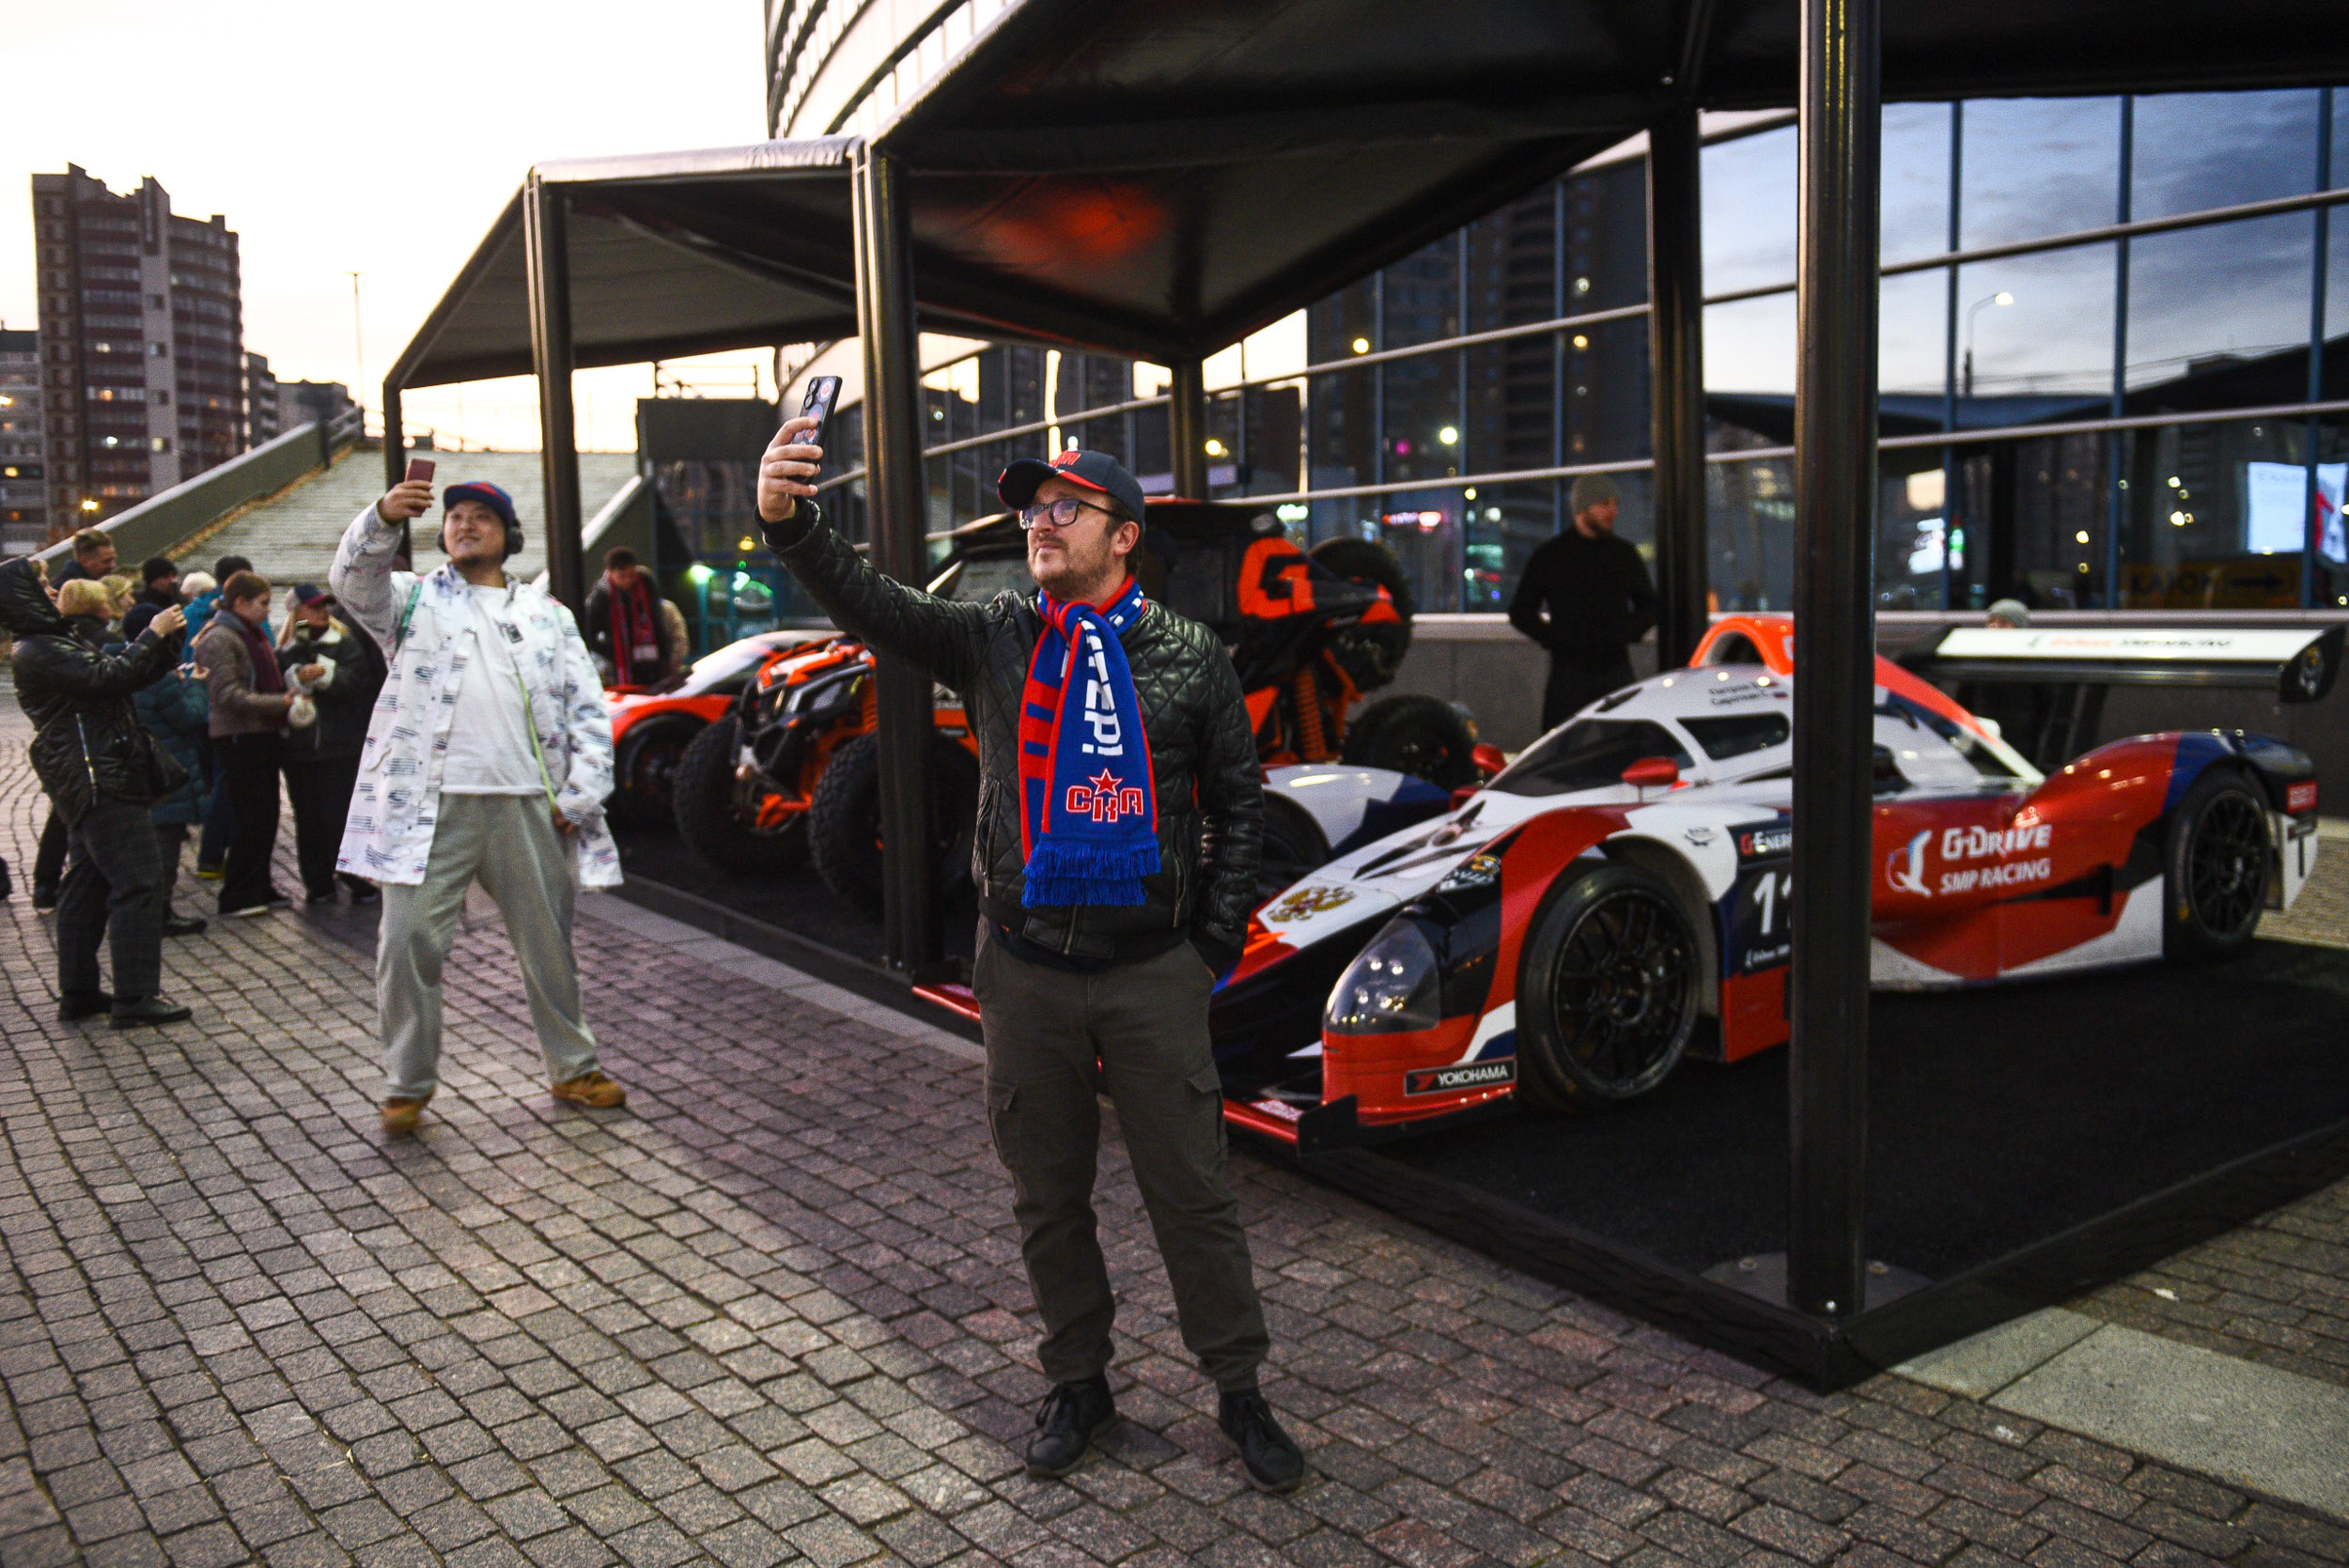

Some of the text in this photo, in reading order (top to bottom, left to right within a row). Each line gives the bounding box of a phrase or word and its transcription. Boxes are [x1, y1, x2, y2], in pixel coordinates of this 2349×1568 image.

[1066, 785, 1143, 822] СКА
[1939, 858, 2051, 895] SMP RACING
[1438, 1064, 1508, 1086] YOKOHAMA
